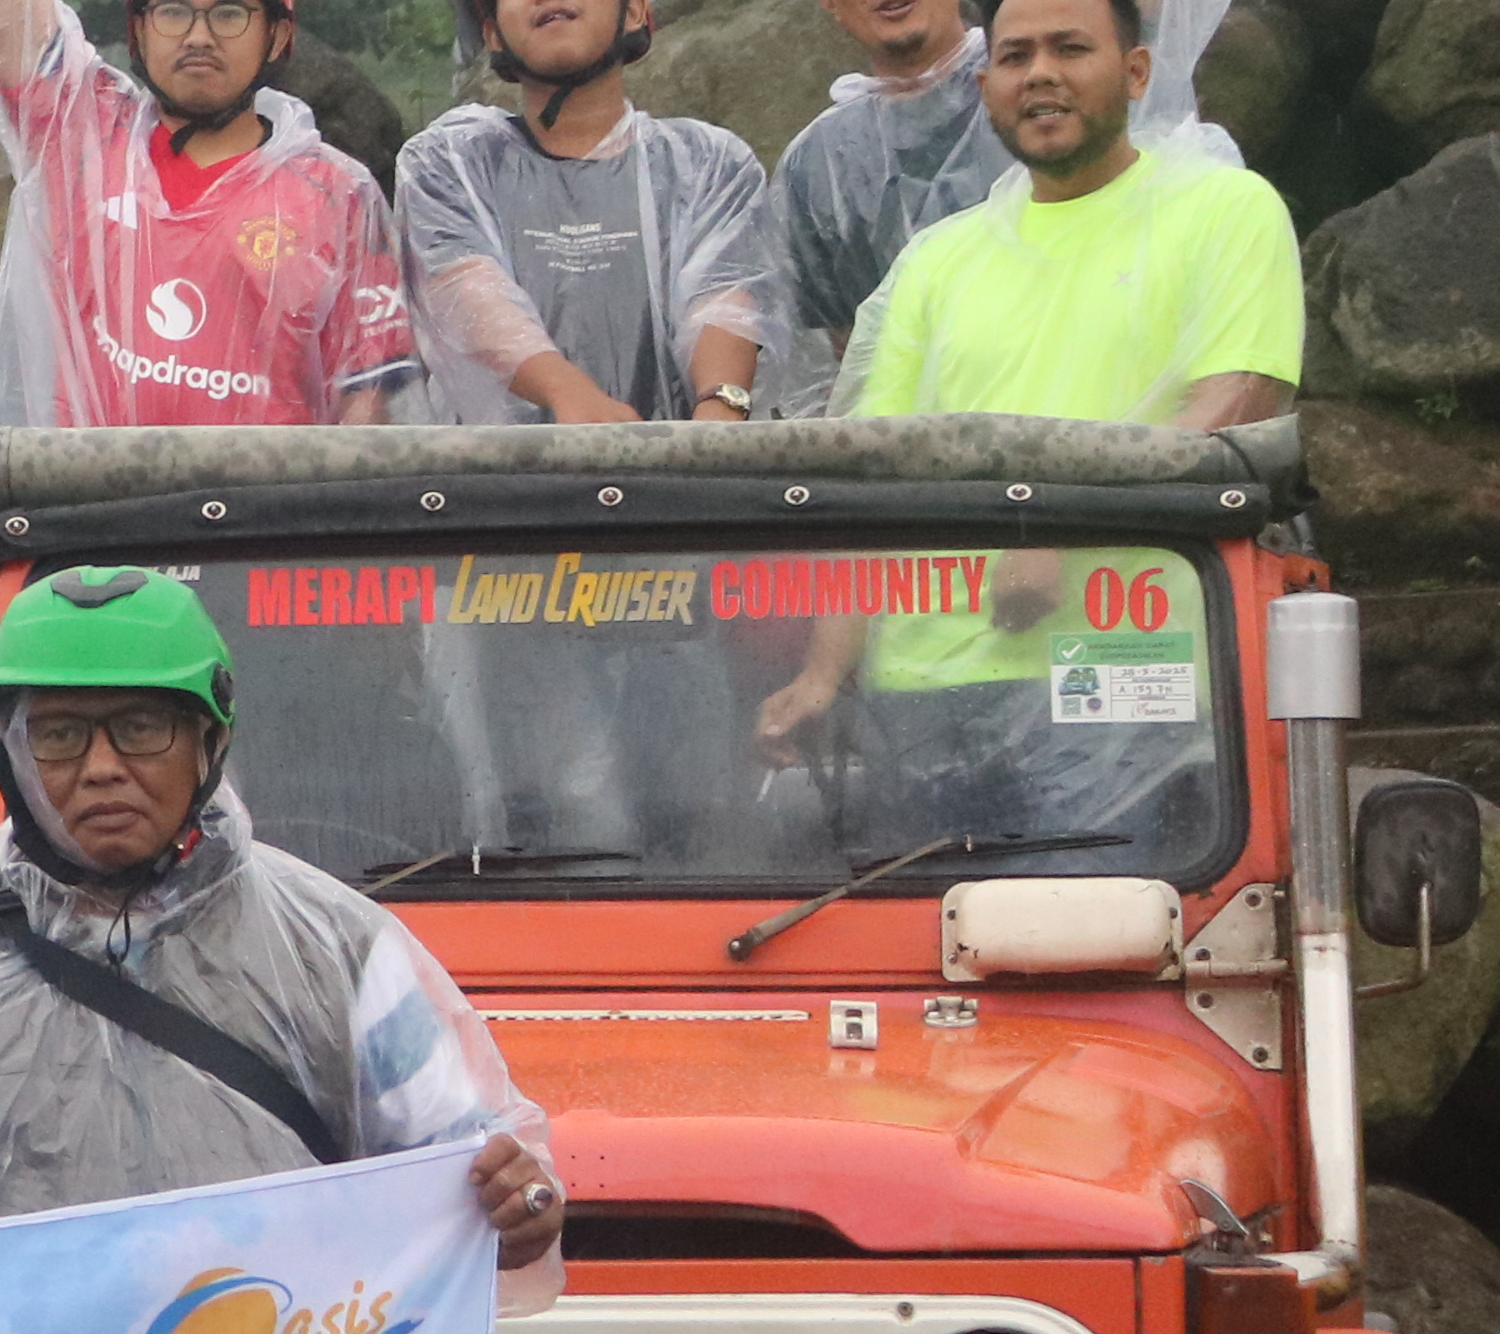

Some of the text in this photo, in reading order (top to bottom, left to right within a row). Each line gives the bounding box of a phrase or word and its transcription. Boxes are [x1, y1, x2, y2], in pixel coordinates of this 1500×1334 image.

[247, 552, 1167, 632] MERAPI LAND CRUISER COMMUNITY 06
